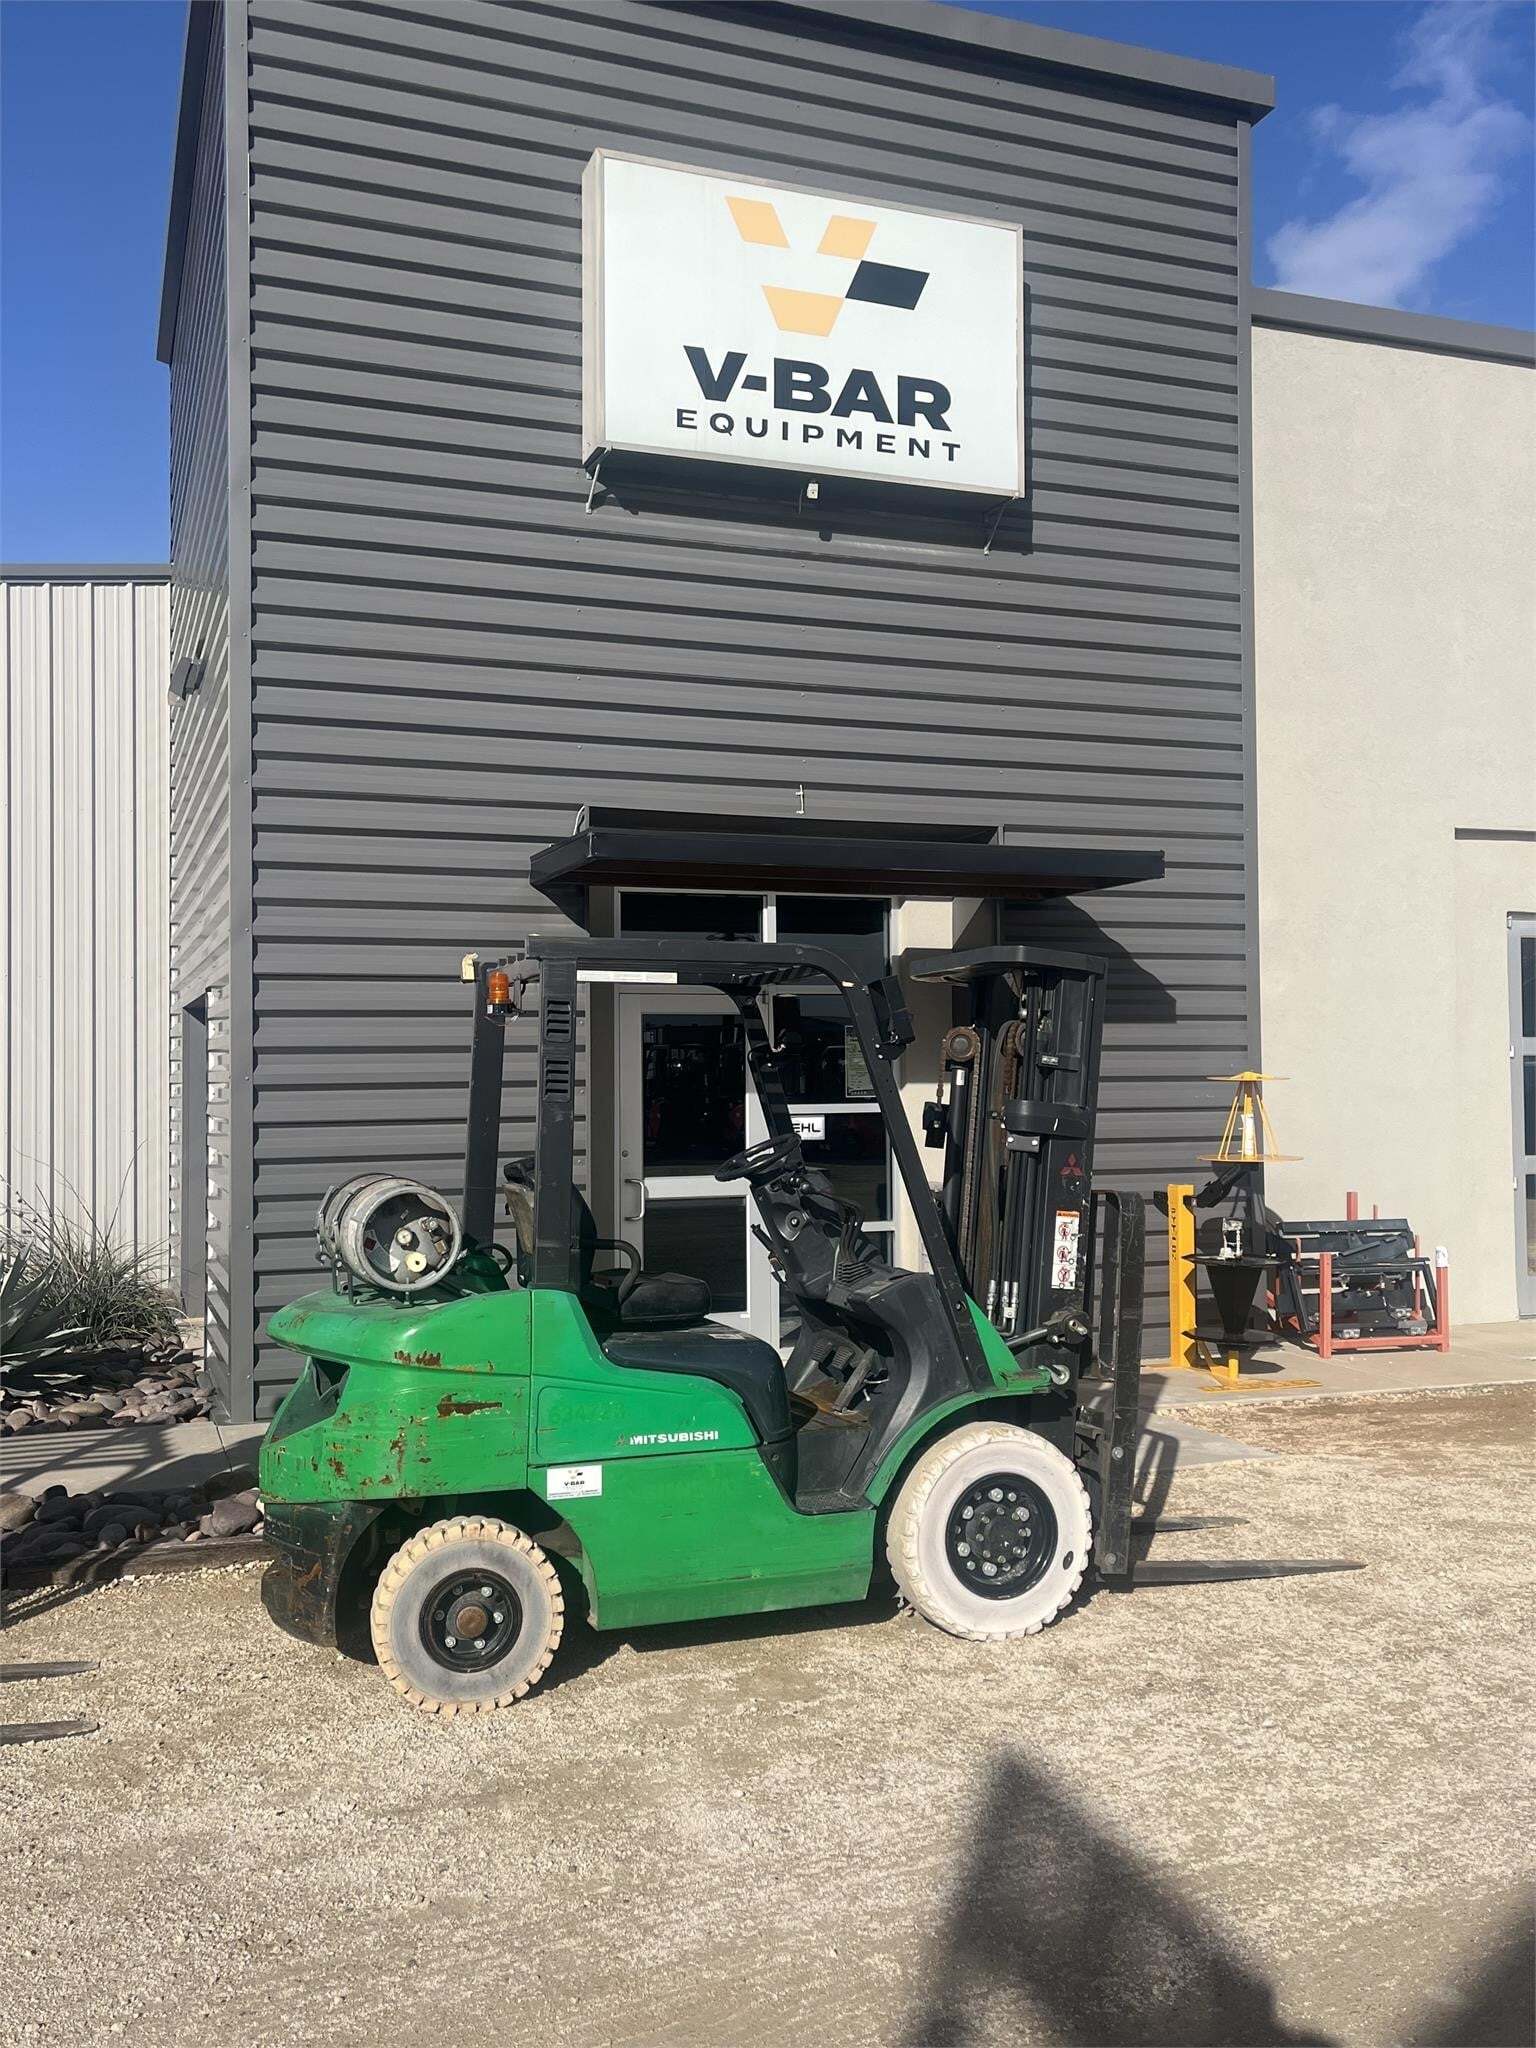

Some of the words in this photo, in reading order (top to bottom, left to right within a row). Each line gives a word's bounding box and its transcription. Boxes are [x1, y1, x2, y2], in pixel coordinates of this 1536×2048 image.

[683, 345, 952, 432] V-BAR
[676, 408, 961, 462] EQUIPMENT
[629, 1430, 719, 1445] MITSUBISHI
